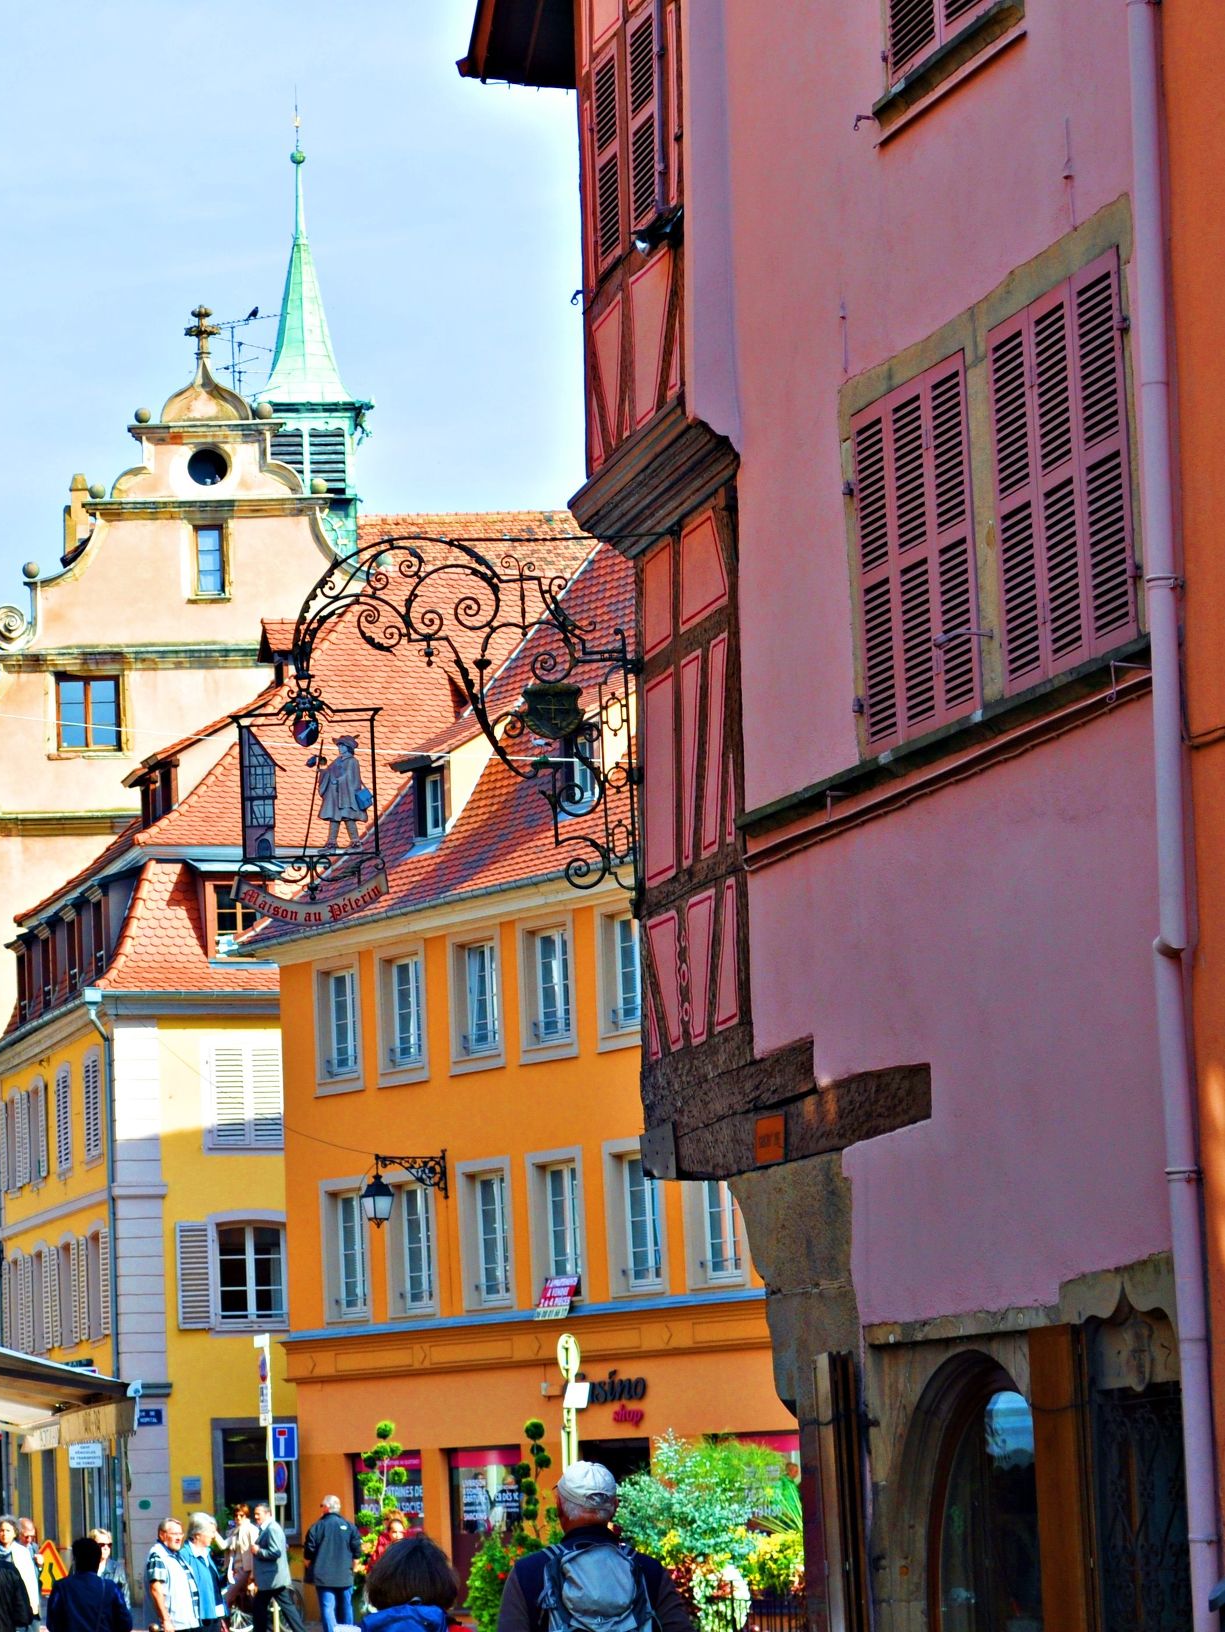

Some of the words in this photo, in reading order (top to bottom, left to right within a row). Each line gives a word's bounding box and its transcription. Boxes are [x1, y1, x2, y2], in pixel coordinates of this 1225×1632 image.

[241, 889, 299, 922] Maison
[304, 911, 322, 923] au
[328, 884, 382, 921] Pélerin
[613, 1403, 644, 1427] shop
